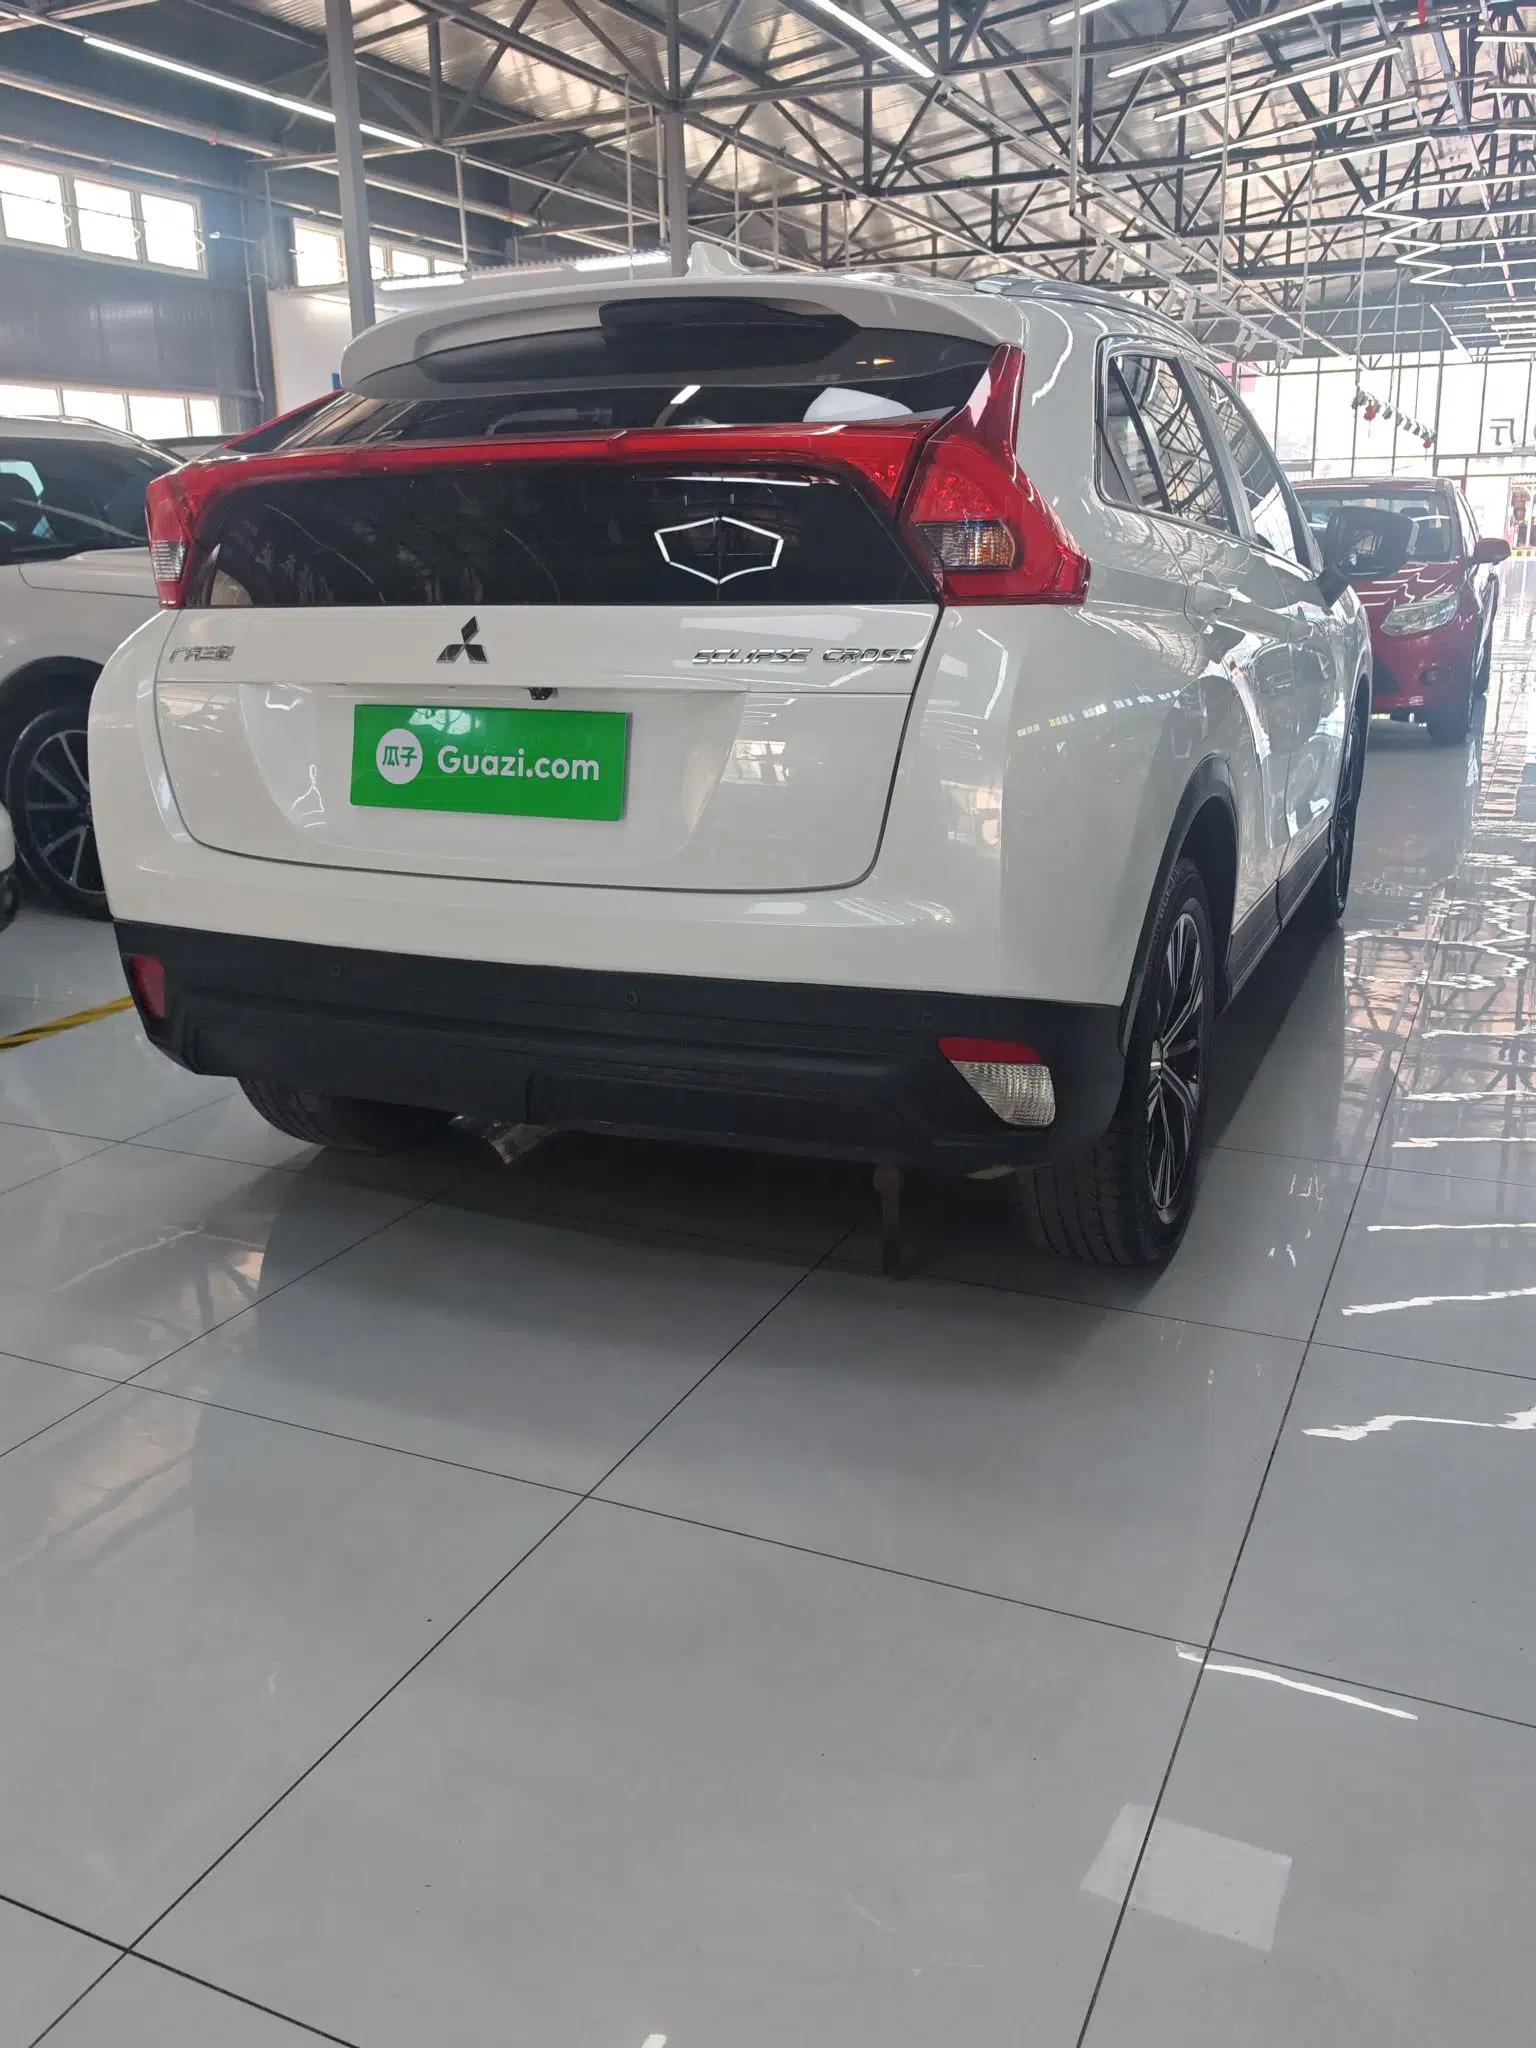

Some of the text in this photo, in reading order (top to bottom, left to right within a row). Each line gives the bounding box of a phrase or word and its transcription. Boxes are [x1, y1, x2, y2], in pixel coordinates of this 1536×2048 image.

[692, 648, 918, 664] ECLIPSE CROSS
[382, 746, 417, 767] 瓜子
[437, 745, 600, 781] Guazi.com
